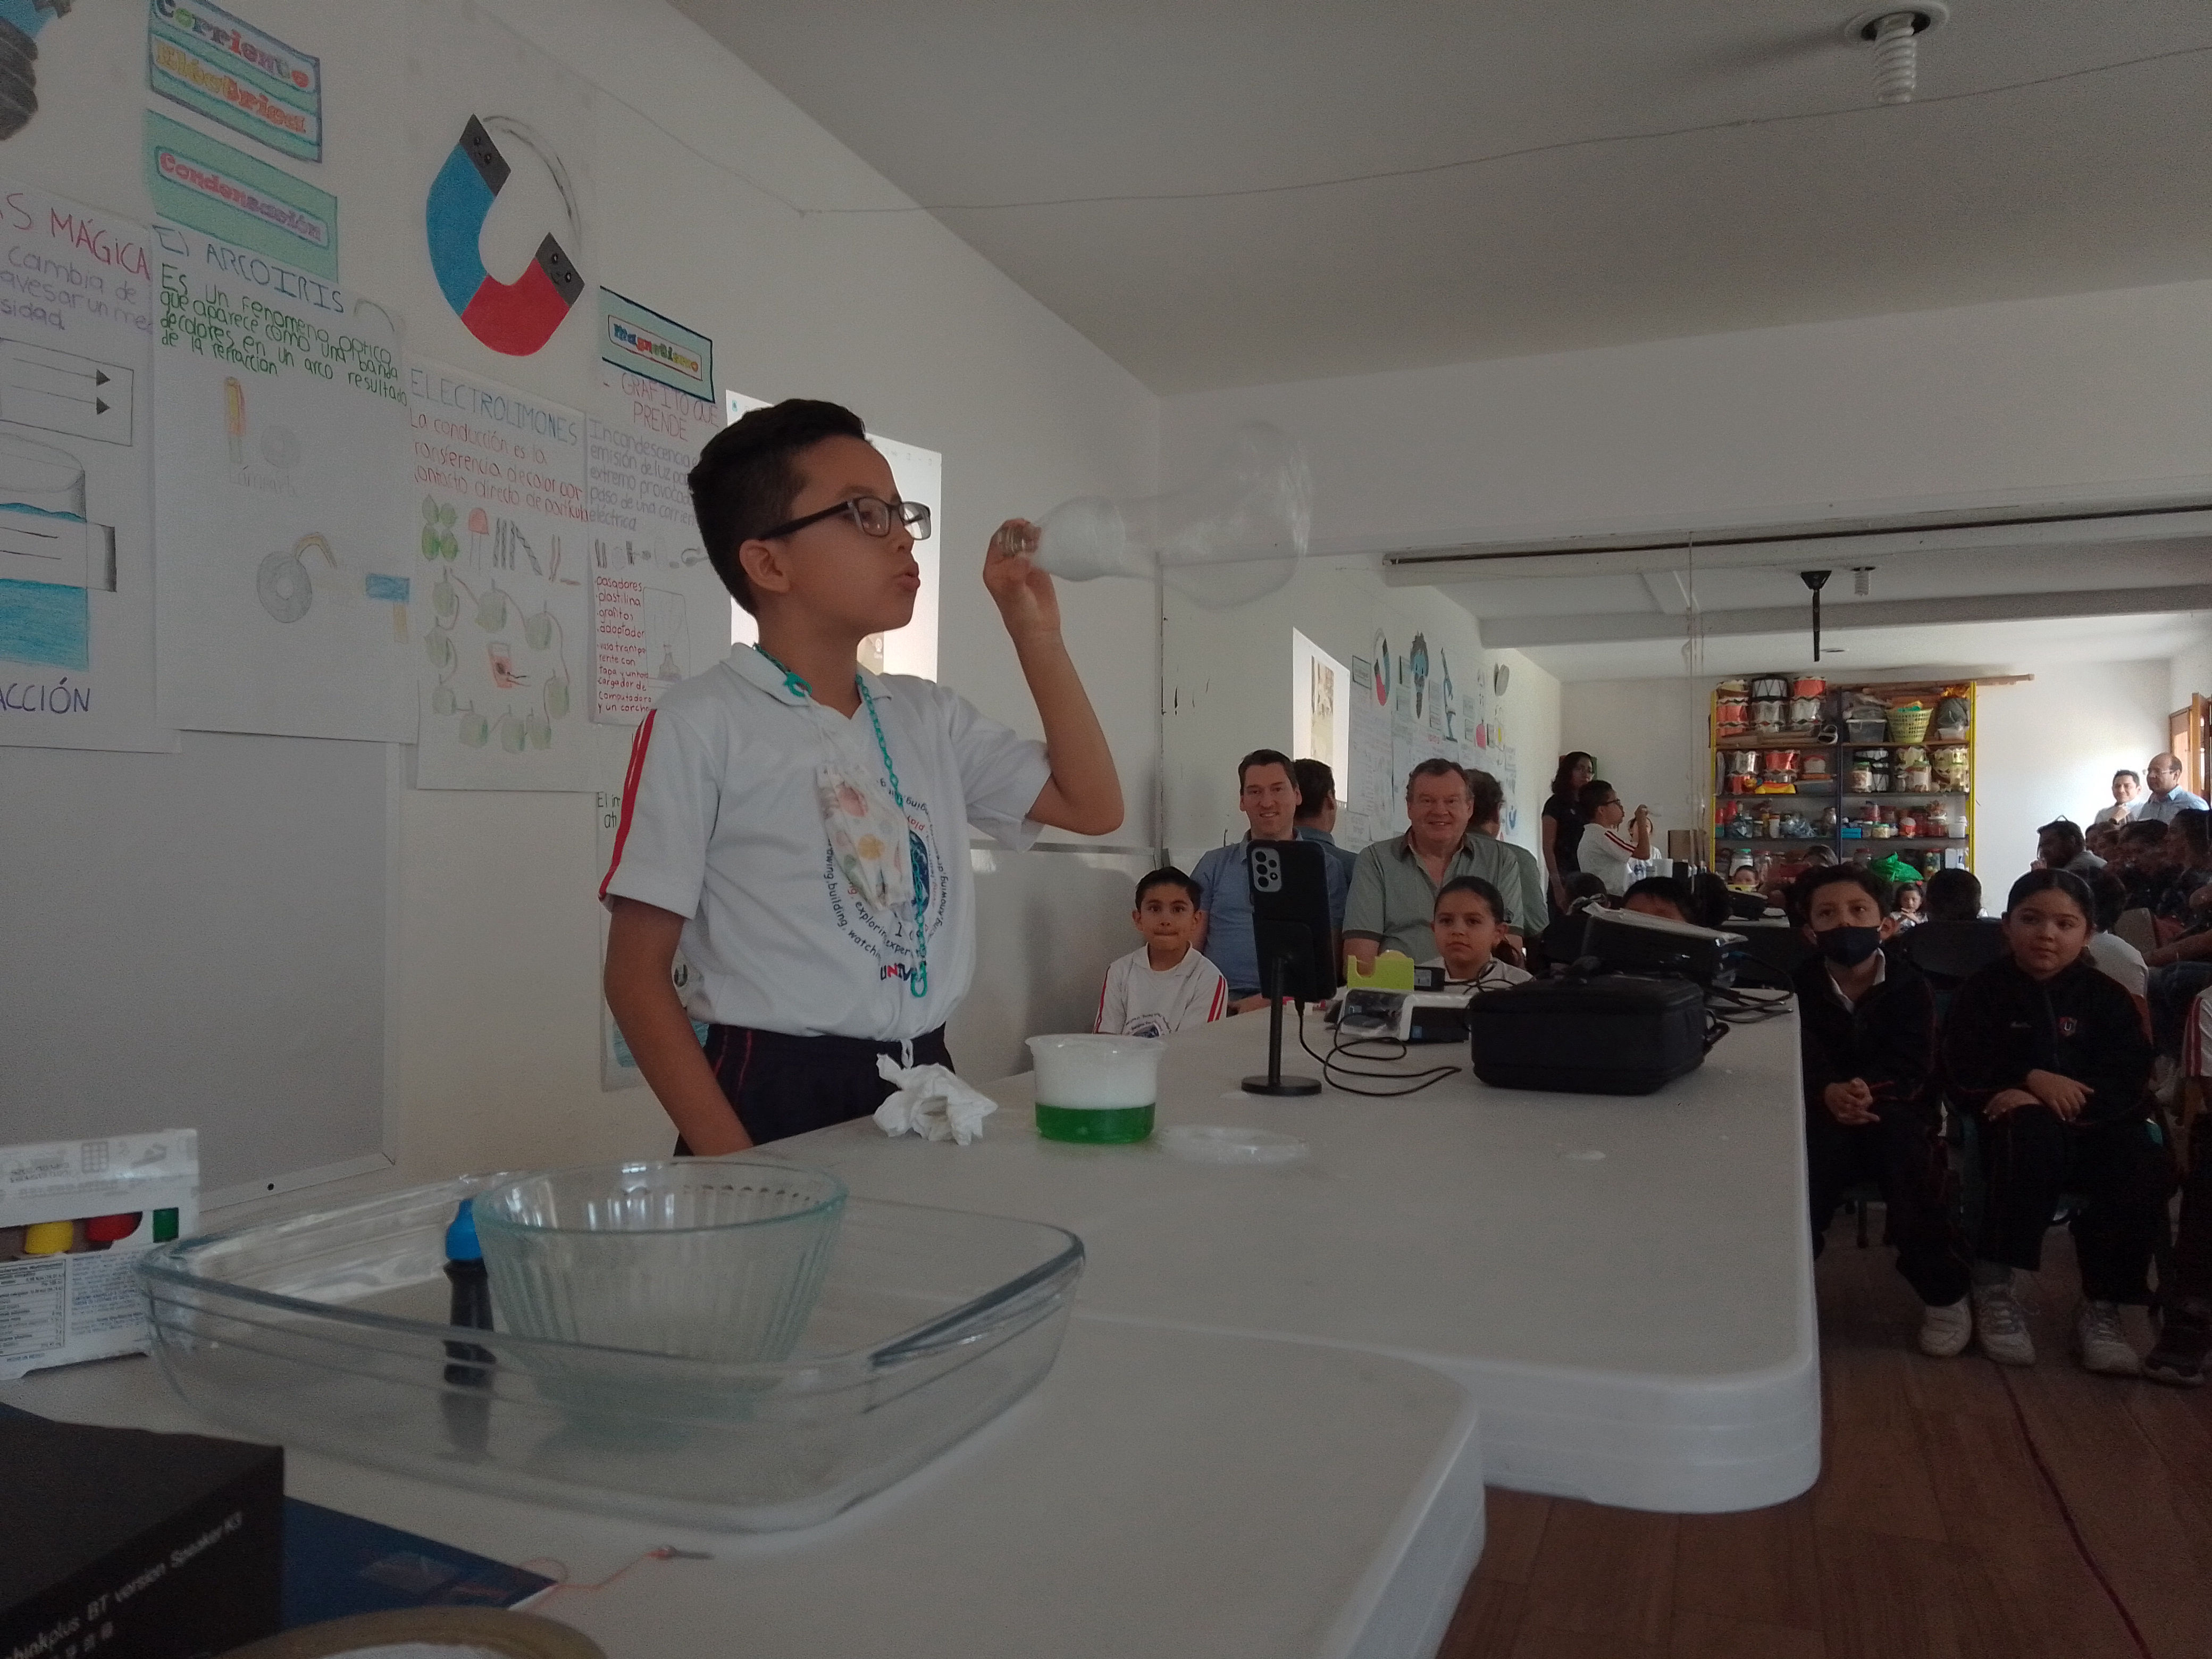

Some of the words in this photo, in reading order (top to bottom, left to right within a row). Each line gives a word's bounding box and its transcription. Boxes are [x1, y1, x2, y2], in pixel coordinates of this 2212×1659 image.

[114, 280, 137, 305] de
[162, 262, 188, 297] Es
[206, 243, 345, 313] ARCOIRIS
[87, 297, 108, 316] un
[160, 291, 189, 317] que
[193, 299, 259, 334] aparece
[266, 323, 311, 353] como
[162, 329, 180, 347] de
[192, 336, 204, 356] la
[243, 335, 266, 357] en
[278, 346, 295, 368] un
[304, 357, 333, 380] arco
[348, 372, 407, 407] resultado
[411, 367, 577, 446] ELECTROLIMONES
[633, 400, 688, 442] PRENDE
[410, 407, 428, 429] La
[514, 443, 525, 459] es
[589, 418, 691, 468] Incandescencia
[590, 445, 637, 469] emisión
[641, 458, 653, 476] de
[475, 479, 520, 506] directo
[590, 466, 636, 492] extremo
[590, 487, 618, 505] paso
[621, 493, 633, 509] de
[599, 664, 617, 678] tapa
[621, 658, 636, 667] con
[636, 681, 647, 691] de
